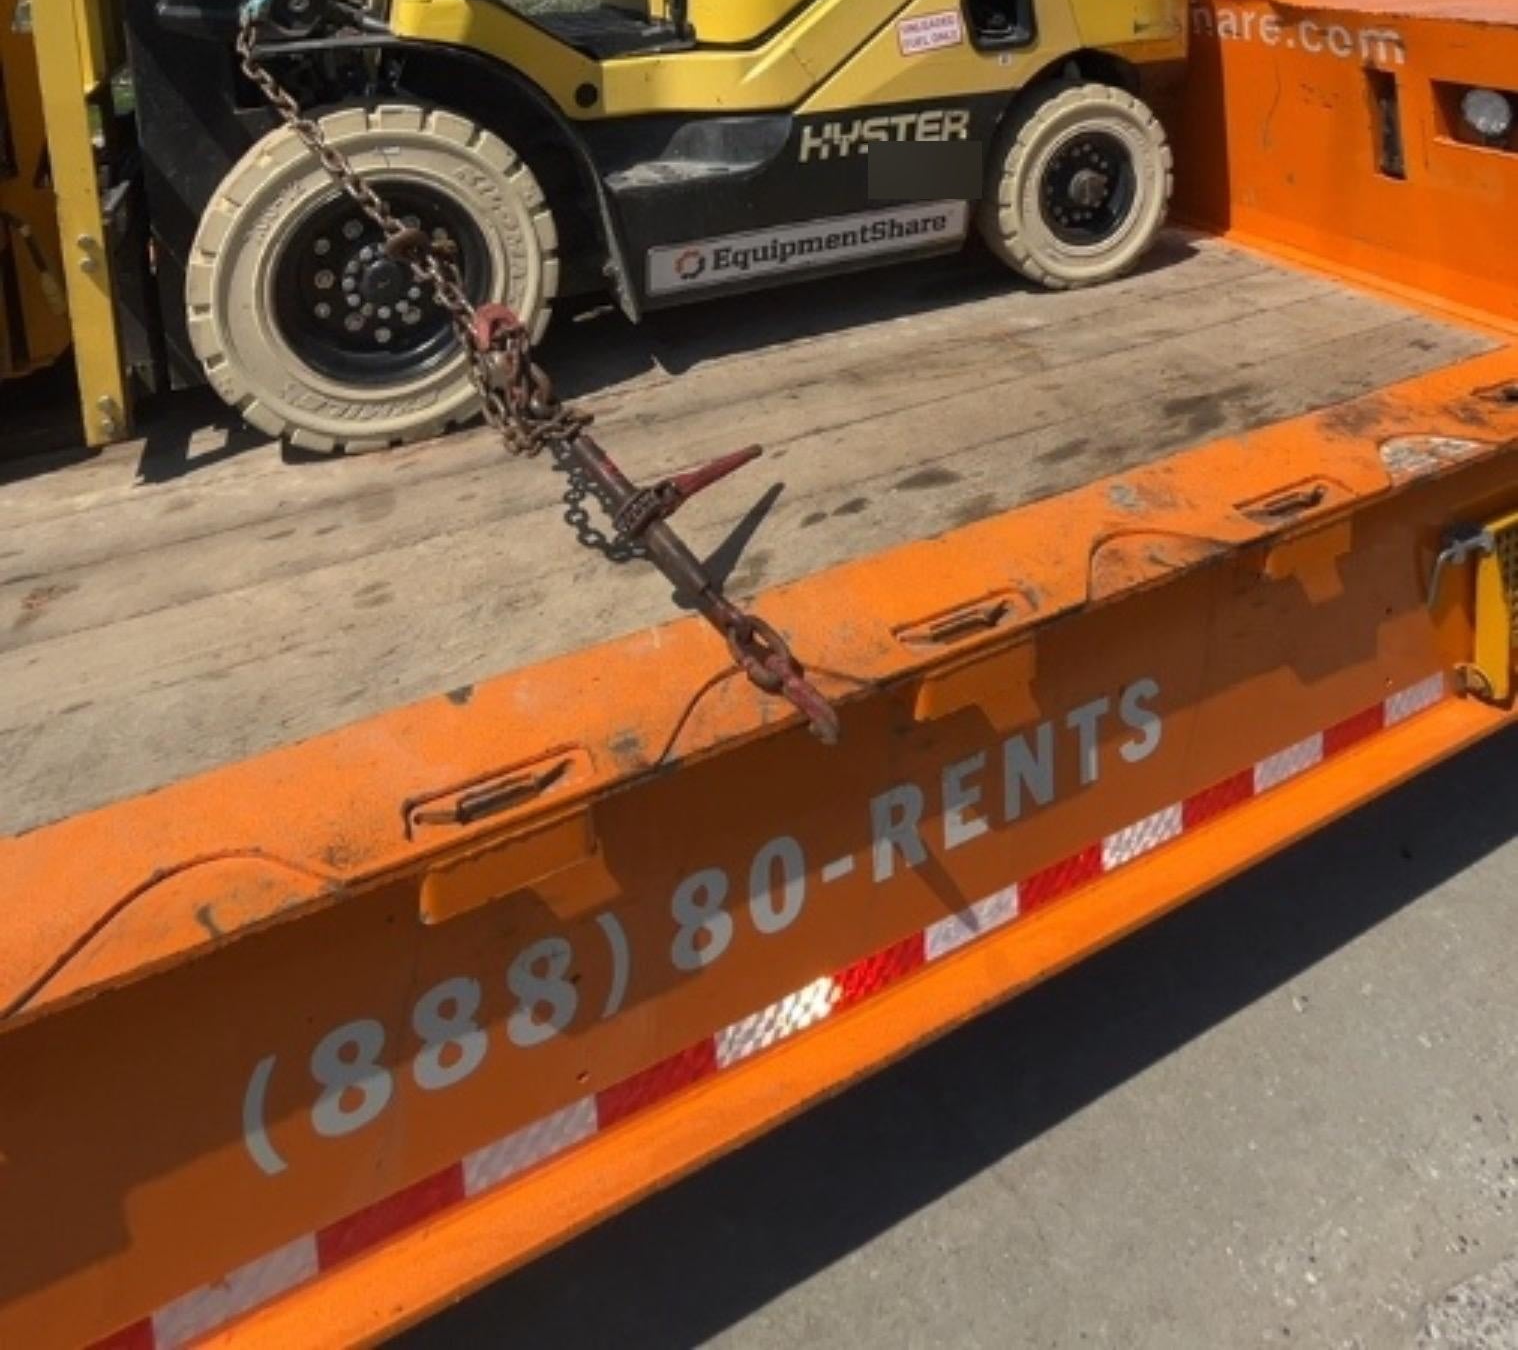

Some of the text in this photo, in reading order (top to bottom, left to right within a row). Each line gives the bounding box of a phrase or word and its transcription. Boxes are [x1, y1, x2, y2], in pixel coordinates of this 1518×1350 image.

[798, 110, 970, 163] HYSTER
[711, 214, 948, 273] EquipmentShare
[242, 677, 1163, 1177] (888) 80-RENTS
